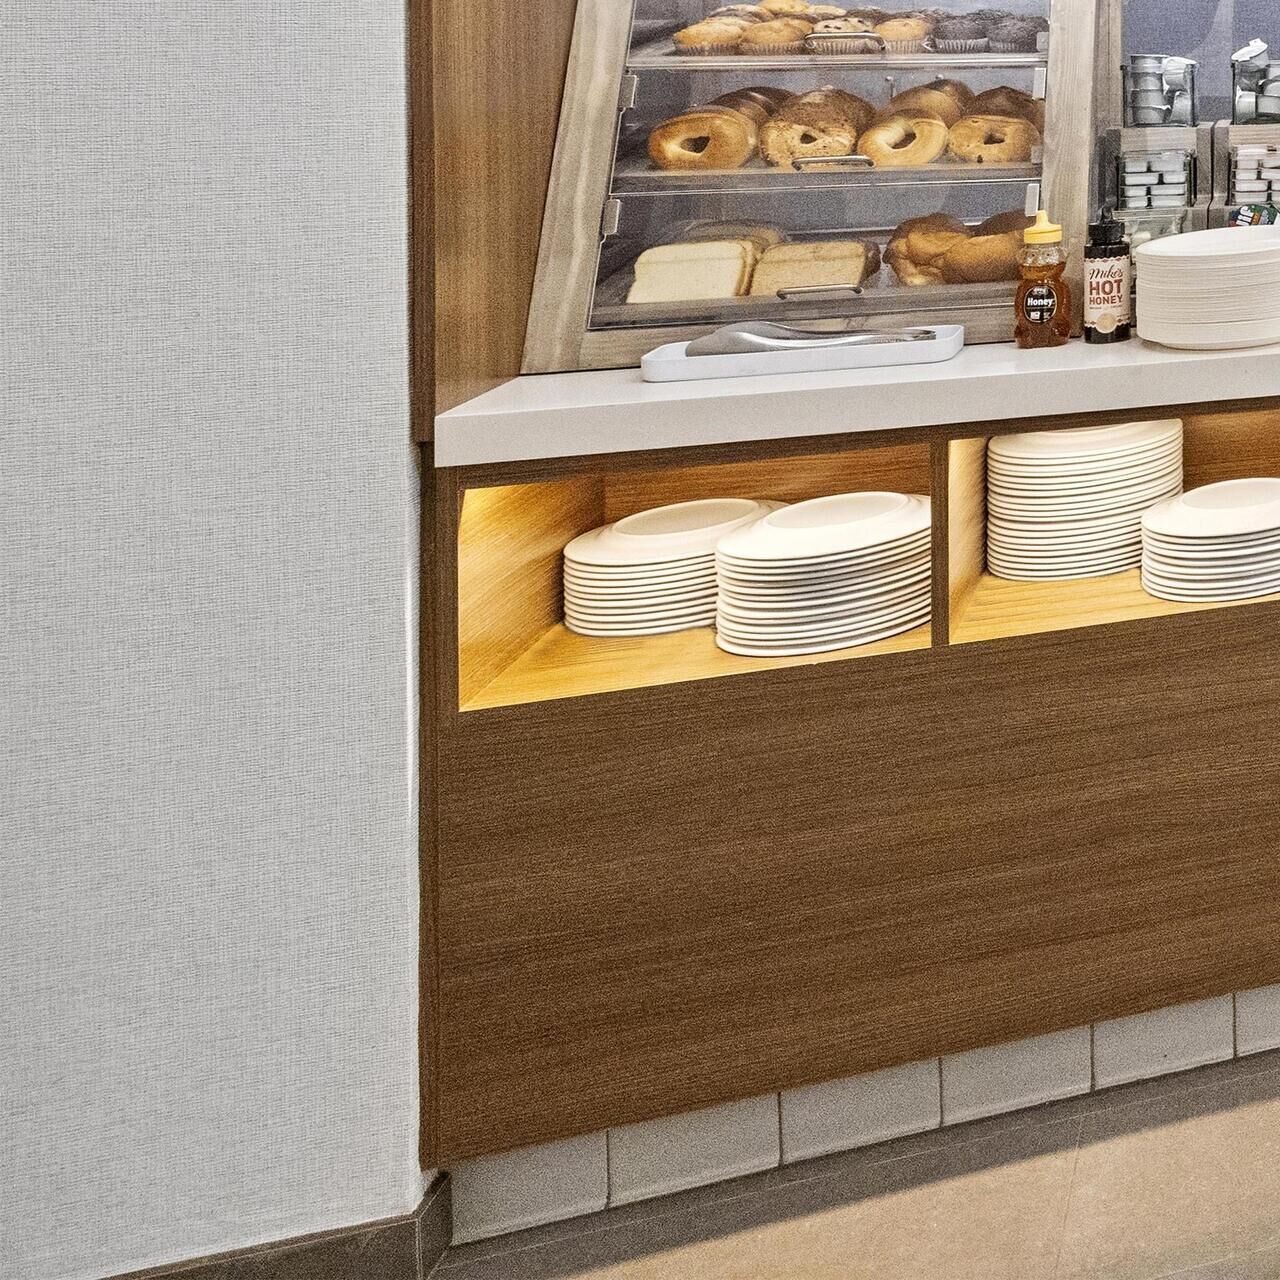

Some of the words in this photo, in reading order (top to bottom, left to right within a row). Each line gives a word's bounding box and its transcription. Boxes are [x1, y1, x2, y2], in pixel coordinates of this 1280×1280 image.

[1089, 264, 1124, 280] Mike's
[1089, 279, 1123, 296] HOT
[1027, 297, 1053, 307] Honey
[1089, 294, 1124, 306] HONEY
